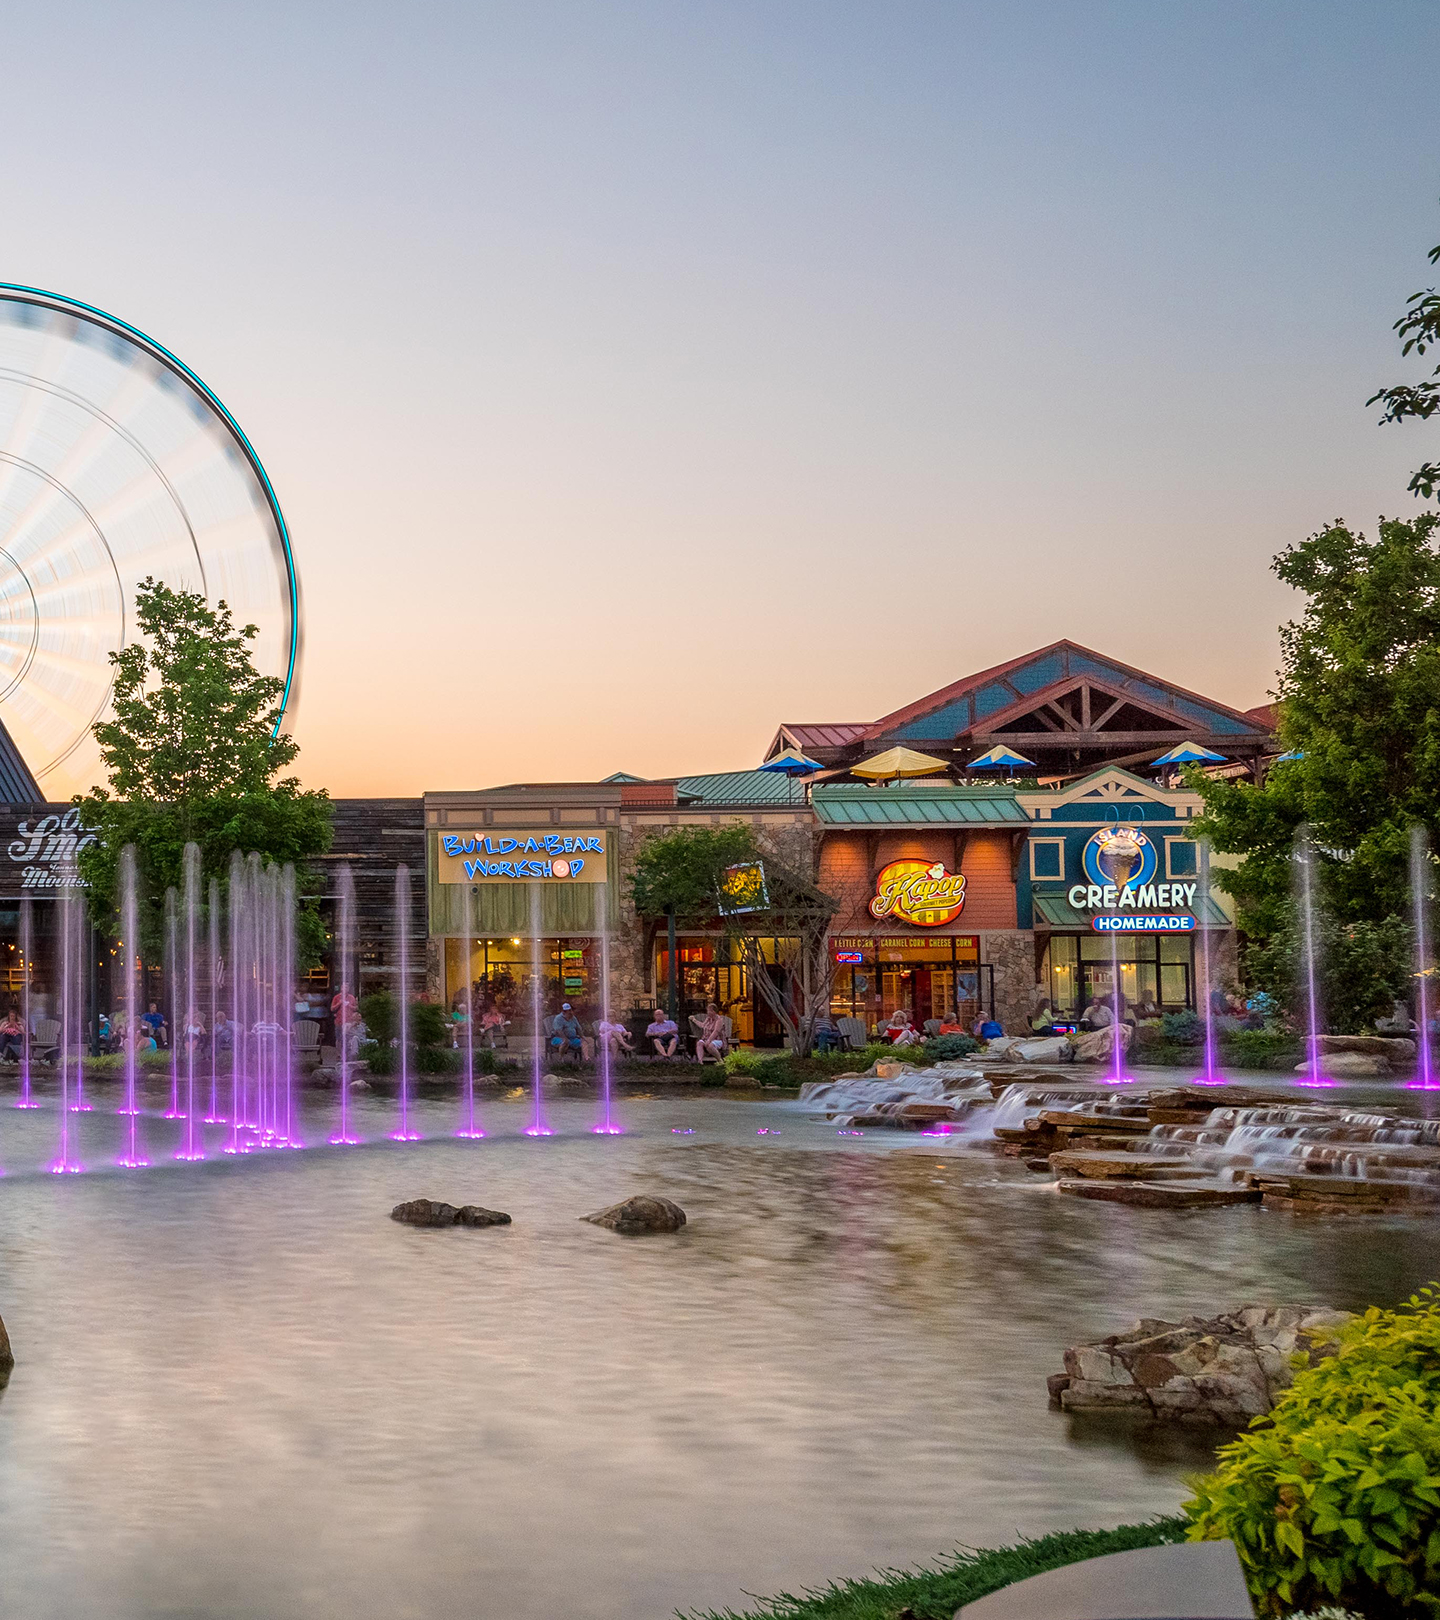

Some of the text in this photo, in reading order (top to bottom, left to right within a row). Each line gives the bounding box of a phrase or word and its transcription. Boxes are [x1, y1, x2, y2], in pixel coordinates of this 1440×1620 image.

[8, 815, 98, 861] Smo
[1094, 828, 1147, 846] ISLAND
[464, 858, 584, 881] WORKSHOP
[871, 871, 966, 916] Kapop
[1068, 883, 1197, 908] CREAMERY
[1099, 917, 1190, 930] HOMEMADE
[880, 938, 908, 948] CARAMEL
[909, 938, 926, 948] CORN
[928, 938, 952, 948] CHEESE
[955, 938, 972, 947] CORN
